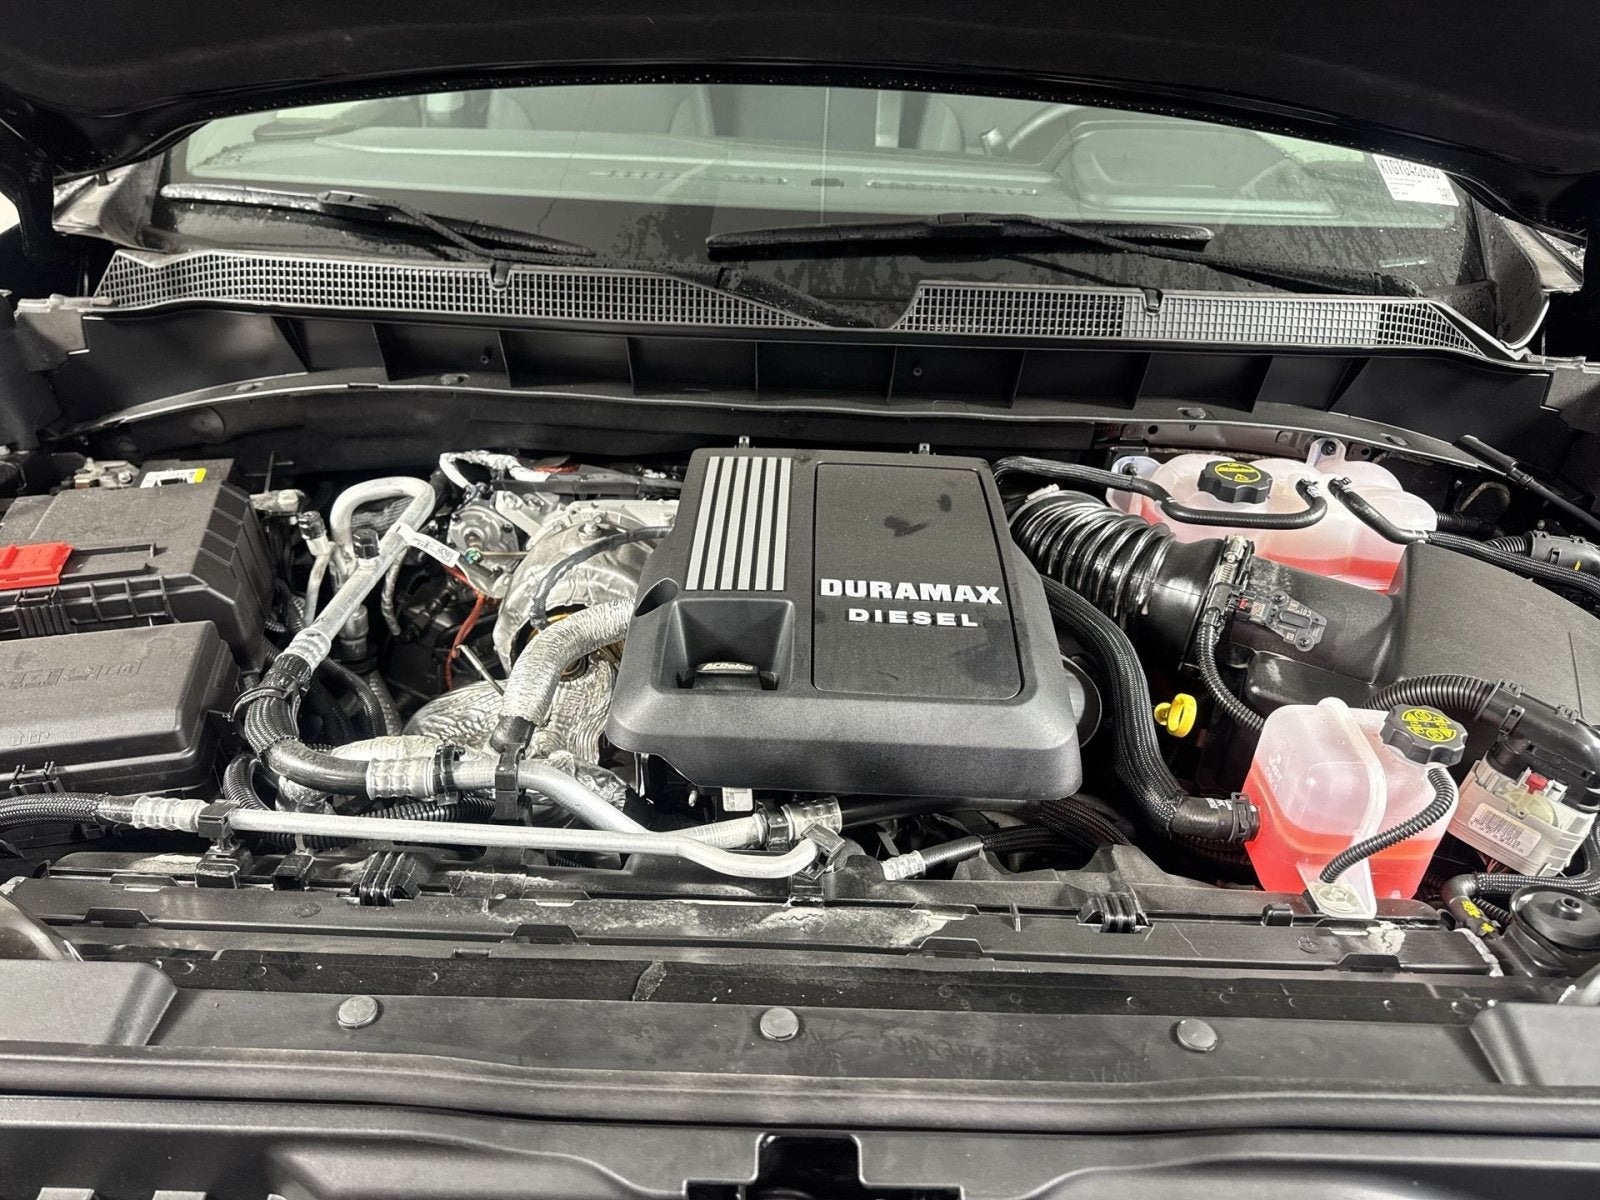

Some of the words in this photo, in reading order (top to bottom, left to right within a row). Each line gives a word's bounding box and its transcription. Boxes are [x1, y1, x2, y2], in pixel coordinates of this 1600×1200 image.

[820, 578, 1002, 605] DURAMAX
[848, 608, 979, 627] DIESEL
[701, 662, 755, 671] ACDelco
